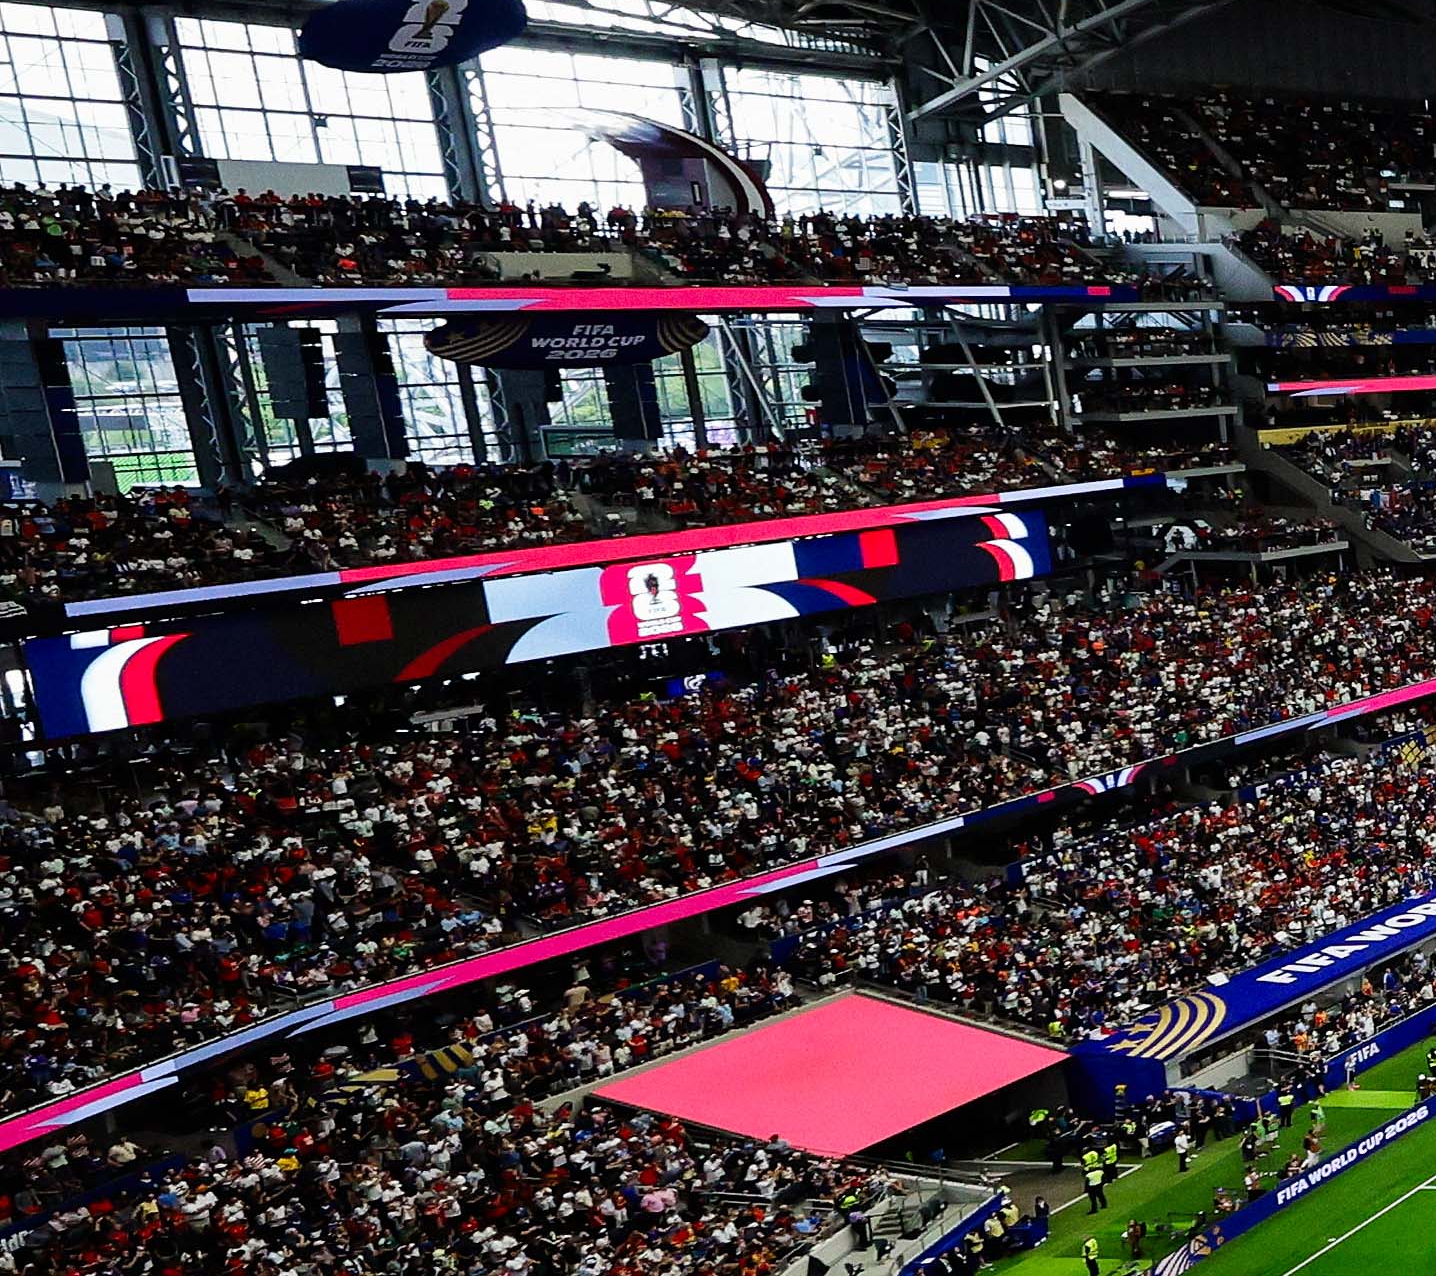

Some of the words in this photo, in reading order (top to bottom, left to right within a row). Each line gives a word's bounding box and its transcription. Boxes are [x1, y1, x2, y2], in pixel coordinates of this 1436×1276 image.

[572, 324, 614, 336] FIFA
[531, 337, 604, 348] WORLD
[607, 335, 646, 346] CUP
[545, 348, 618, 360] 2026
[1256, 944, 1369, 985] FIFA
[1351, 1043, 1380, 1063] FIFA
[1277, 1179, 1310, 1205] FIFA
[1309, 1149, 1358, 1185] WORLD
[1357, 1132, 1384, 1155] CUP
[1384, 1105, 1429, 1140] 2026
